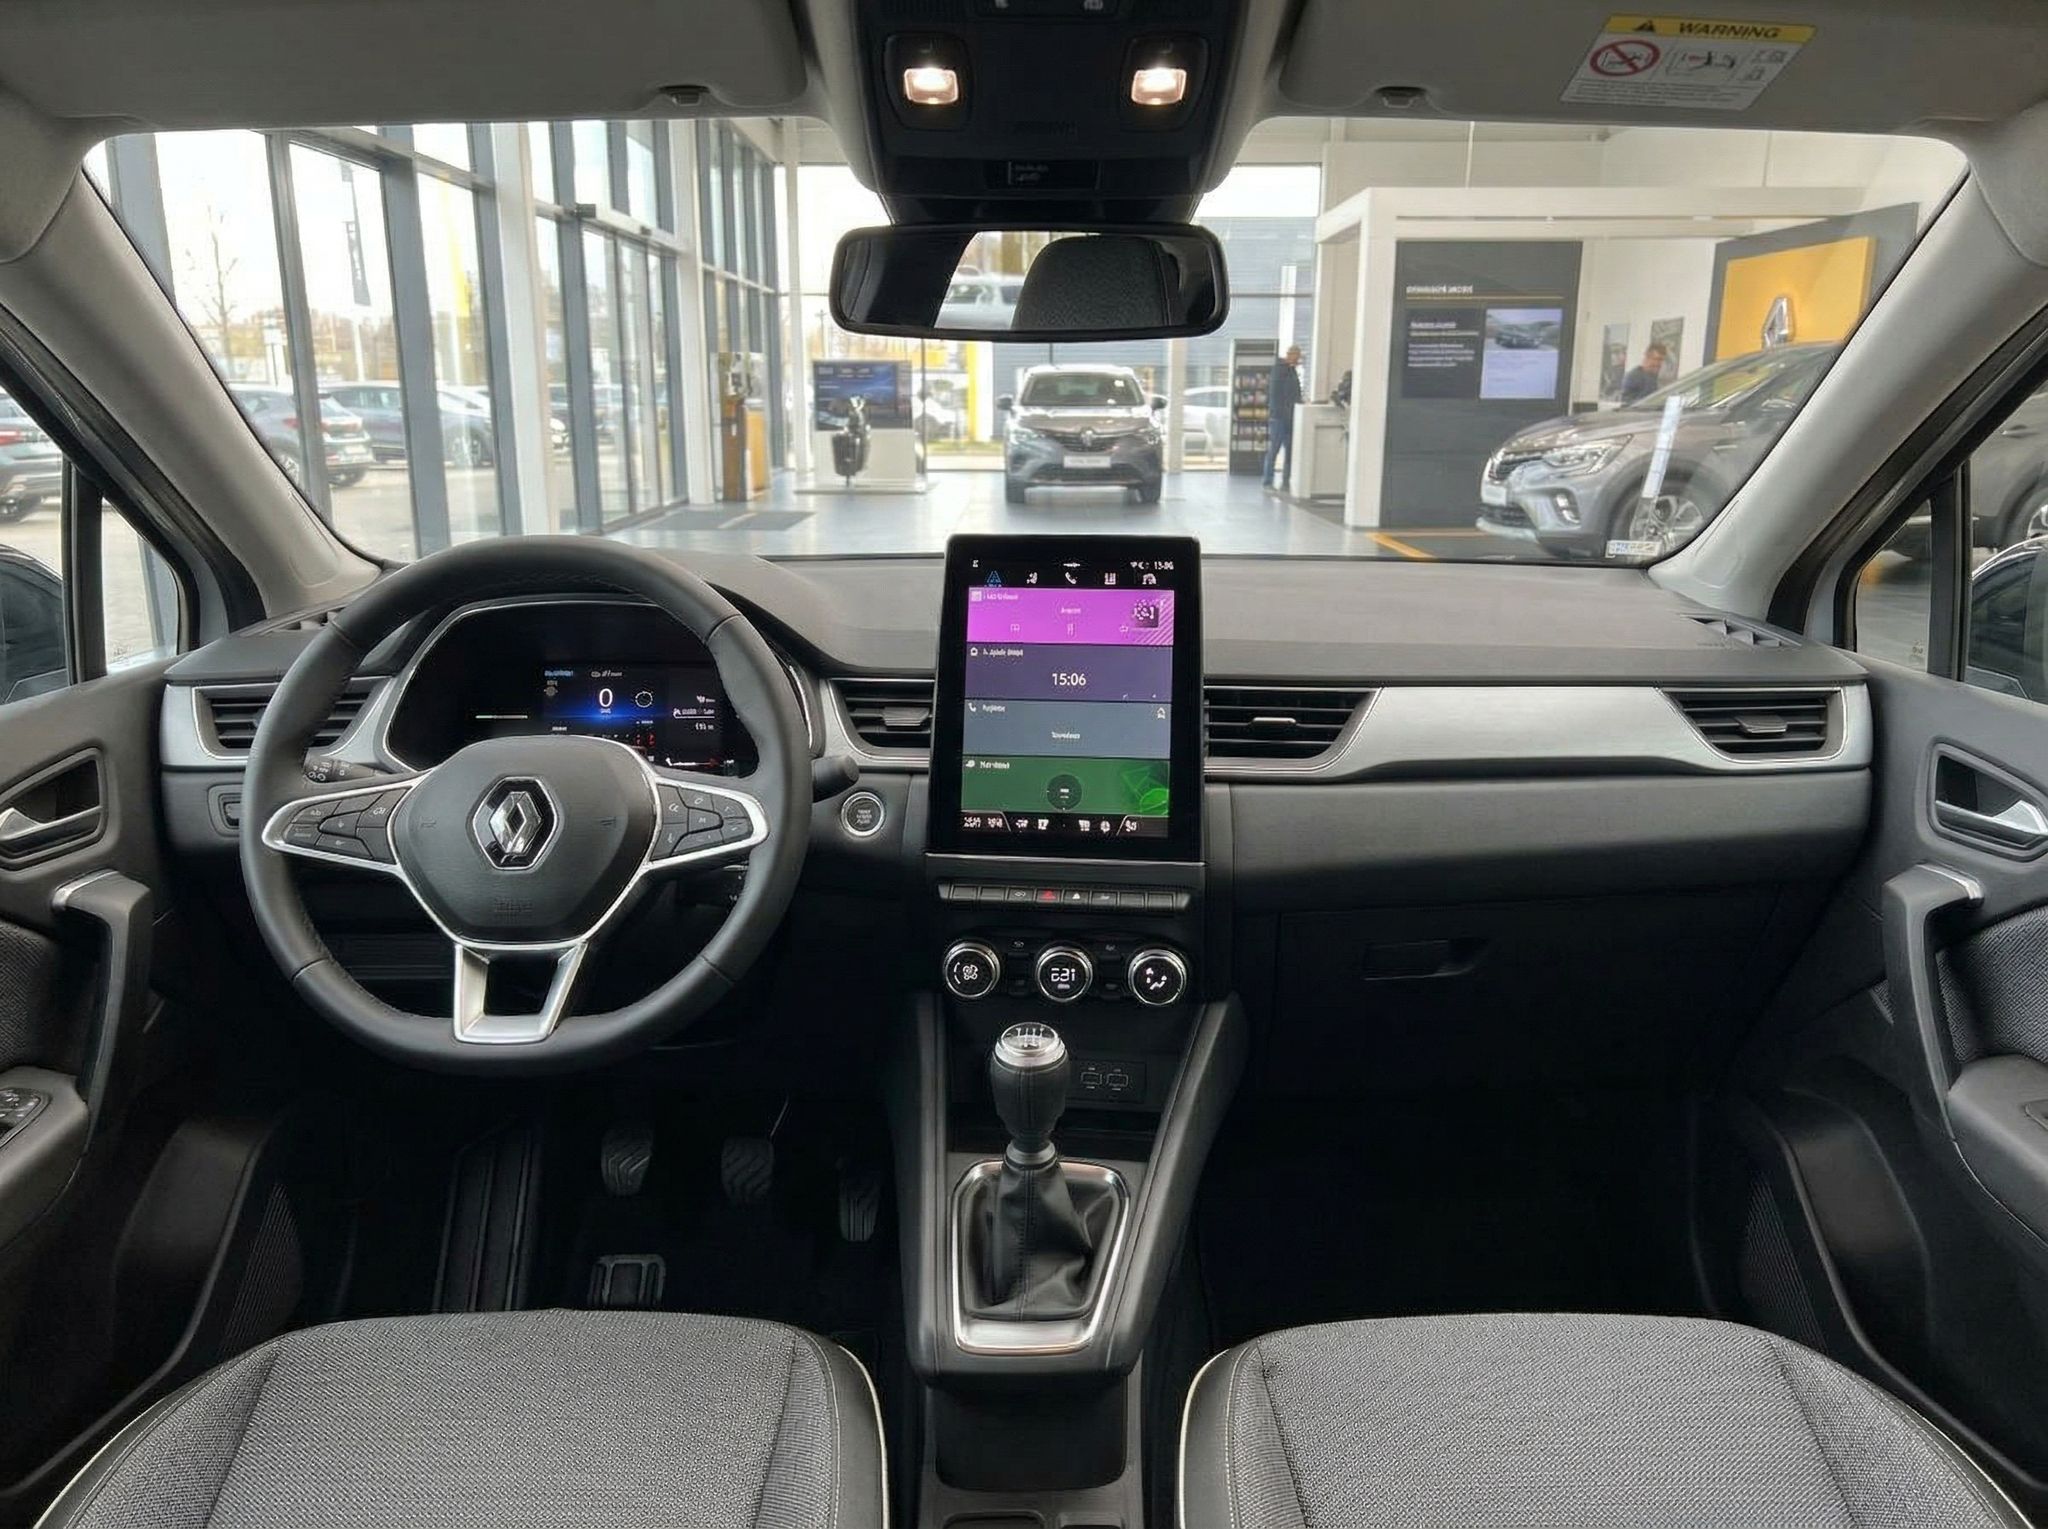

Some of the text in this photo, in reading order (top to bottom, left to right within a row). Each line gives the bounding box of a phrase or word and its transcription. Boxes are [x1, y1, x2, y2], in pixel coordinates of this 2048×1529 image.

[1679, 21, 1781, 39] WARNING
[1051, 672, 1087, 686] 15:06
[599, 688, 613, 708] 0
